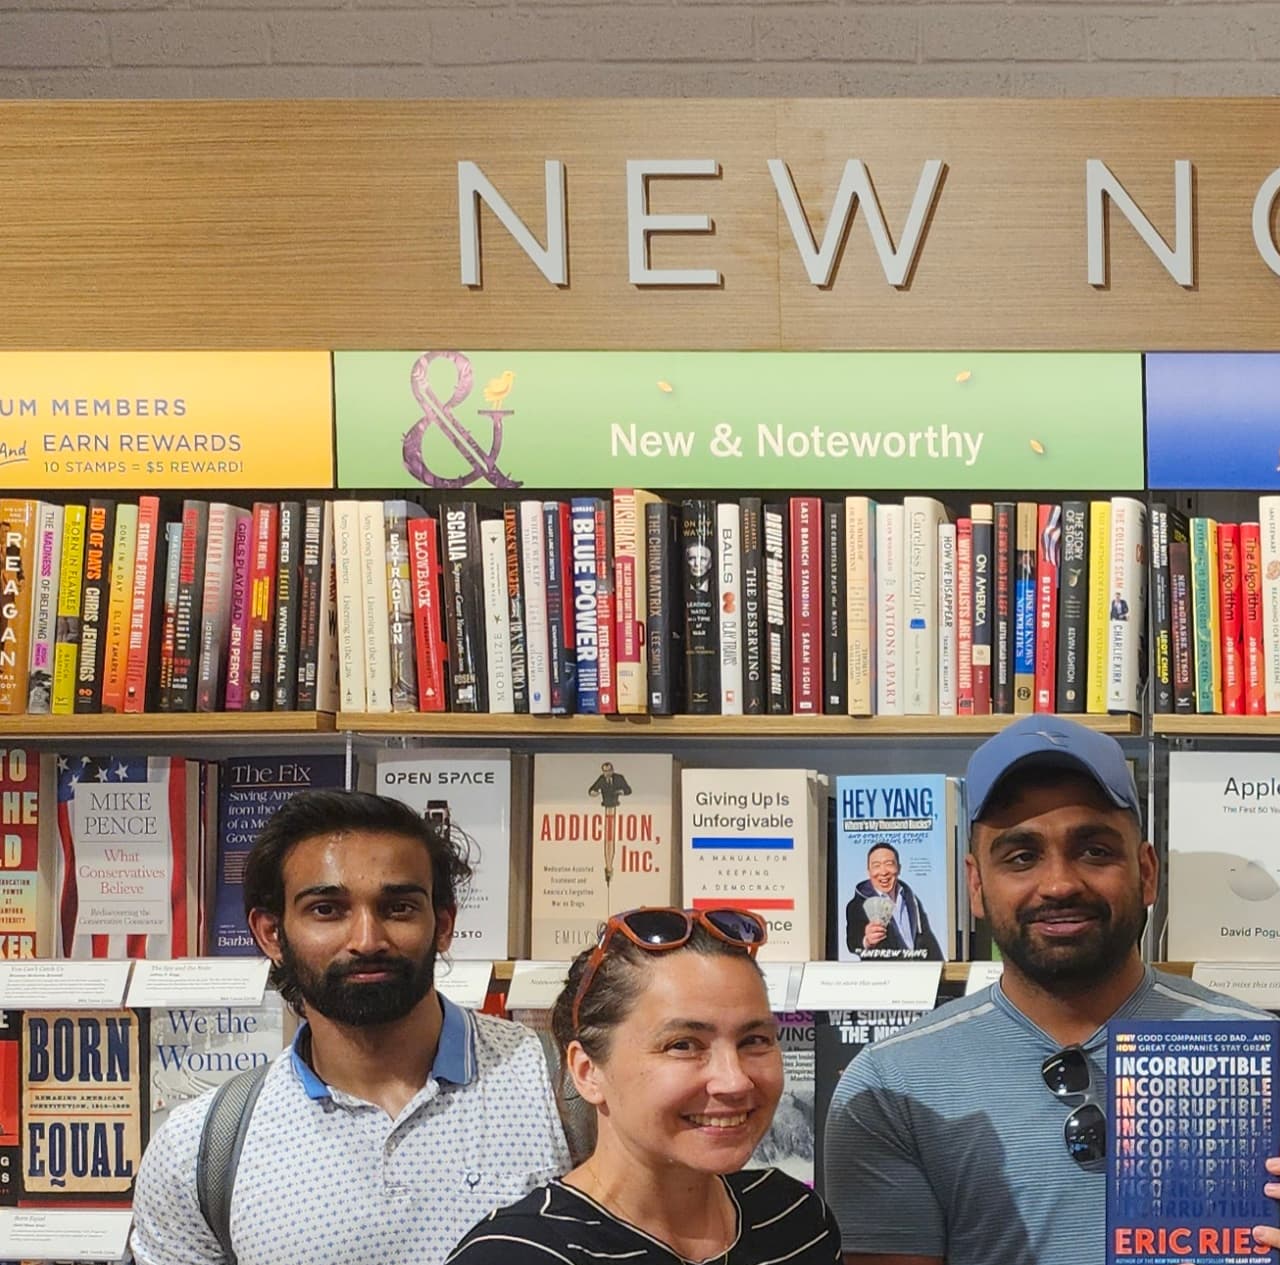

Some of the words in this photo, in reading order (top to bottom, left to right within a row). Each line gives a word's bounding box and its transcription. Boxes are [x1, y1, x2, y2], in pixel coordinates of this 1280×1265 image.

[458, 158, 949, 289] NEW
[52, 399, 187, 416] MEMBERS
[43, 434, 110, 452] EARN
[119, 434, 242, 452] REWARDS
[610, 423, 696, 458] New
[709, 423, 743, 458] &
[757, 422, 984, 466] Noteworthy
[44, 461, 60, 473] 10
[65, 461, 127, 473] STAMPS
[146, 460, 164, 474] $5
[170, 461, 244, 473] REWARD!
[447, 510, 468, 562] SCALIA
[573, 518, 595, 574] BLUE
[721, 528, 733, 584] BALLS
[414, 530, 430, 609] BLOWBACK
[389, 533, 403, 645] EXTRACTION
[575, 577, 599, 661] POWER
[231, 765, 275, 782] The
[281, 764, 311, 782] Fix
[384, 772, 431, 784] OPEN
[438, 772, 495, 784] SPACE
[88, 792, 152, 812] MIKE
[695, 792, 749, 810] Giving
[751, 792, 773, 809] Up
[775, 792, 790, 807] Is
[842, 788, 881, 819] HEY
[884, 786, 939, 820] YANG,
[1222, 806, 1239, 814] The
[1240, 806, 1255, 814] First
[1257, 806, 1268, 814] 50
[83, 815, 158, 835] PENCE
[540, 814, 661, 844] ADDICTION,
[693, 813, 794, 832] Unforgivable
[103, 849, 139, 864] What
[620, 846, 661, 873] Inc.
[78, 864, 167, 880] Conservatives
[99, 881, 144, 895] Believe
[1220, 926, 1251, 938] David
[1208, 978, 1229, 989] Don't
[1232, 979, 1249, 989] miss
[1251, 979, 1267, 989] this
[167, 1010, 210, 1034] We
[216, 1009, 257, 1034] the
[28, 1018, 132, 1083] BORN
[158, 1045, 268, 1073] Women
[1115, 1056, 1272, 1076] INCORRUPTIBLE
[28, 1122, 133, 1187] EQUAL
[1114, 1227, 1192, 1255] ERIC
